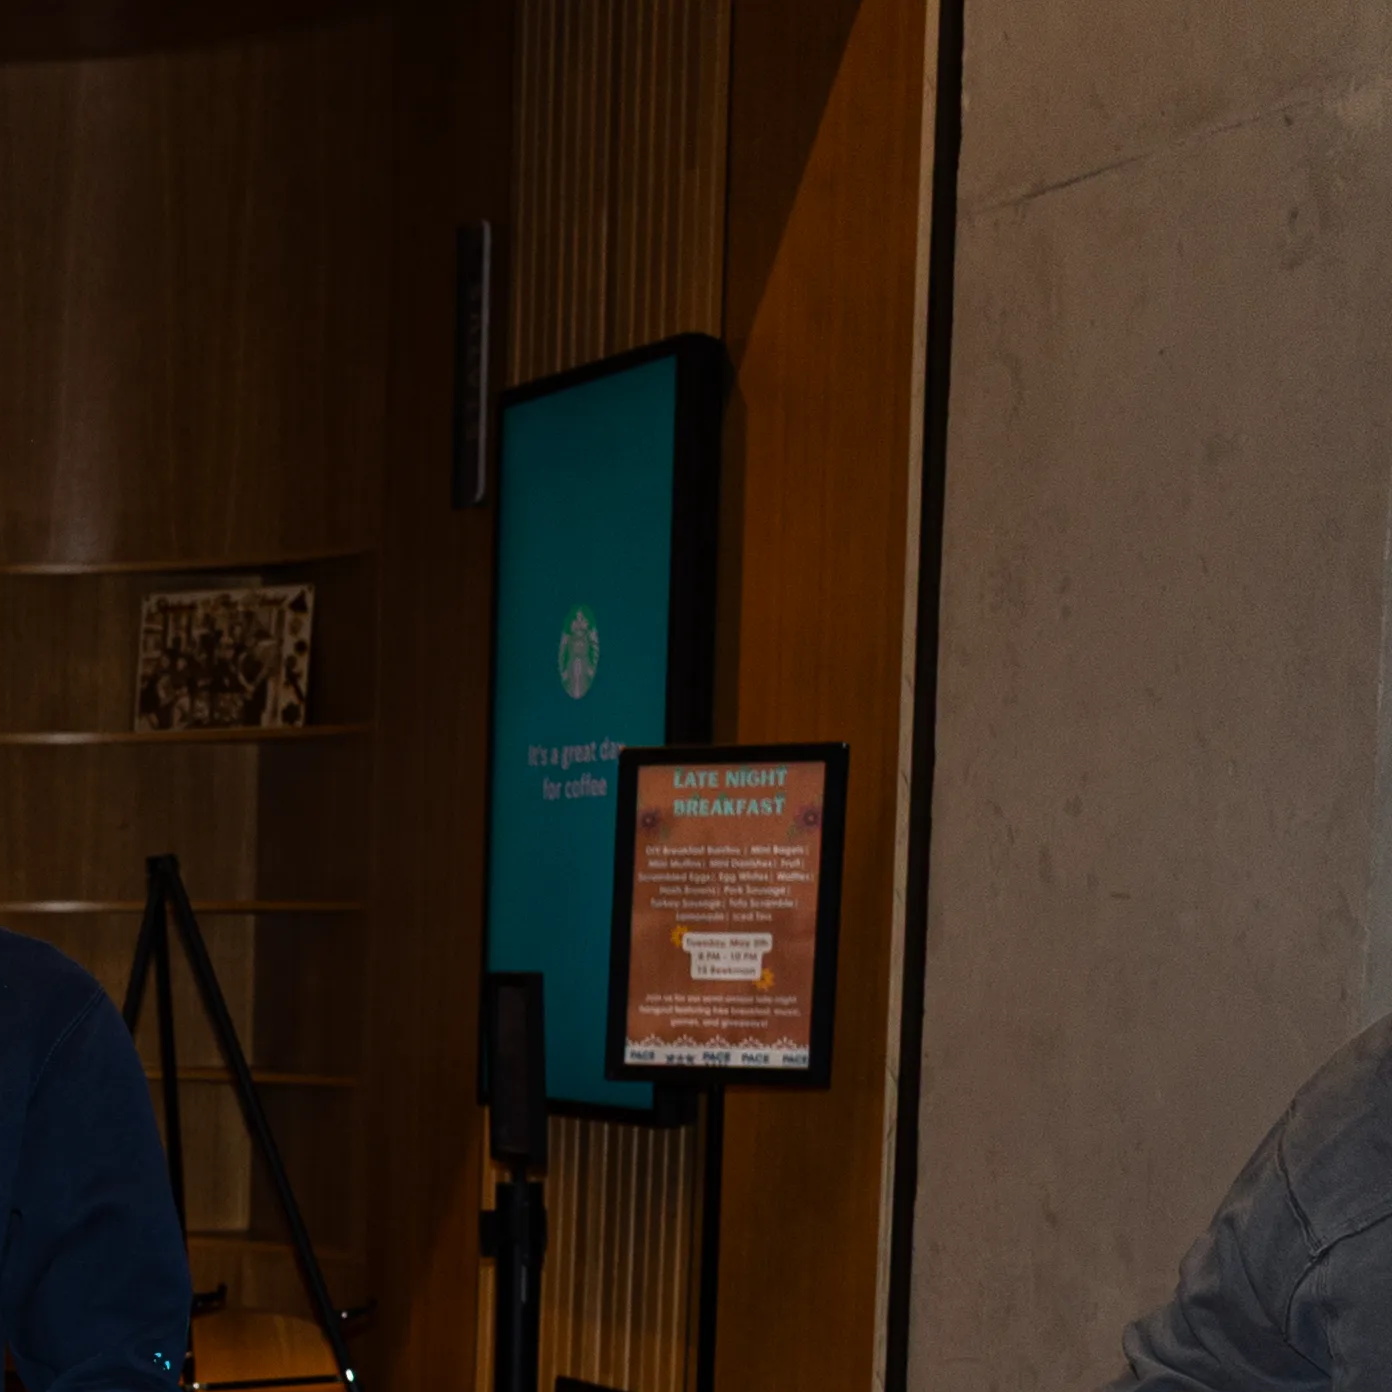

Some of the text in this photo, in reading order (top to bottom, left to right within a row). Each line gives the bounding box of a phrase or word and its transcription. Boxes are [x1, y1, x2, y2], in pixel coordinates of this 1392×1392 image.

[528, 745, 547, 767] It's
[561, 741, 597, 770] great
[543, 772, 607, 800] for coffee
[673, 765, 788, 788] LATE NIGHT
[673, 795, 786, 816] BREAKFAST
